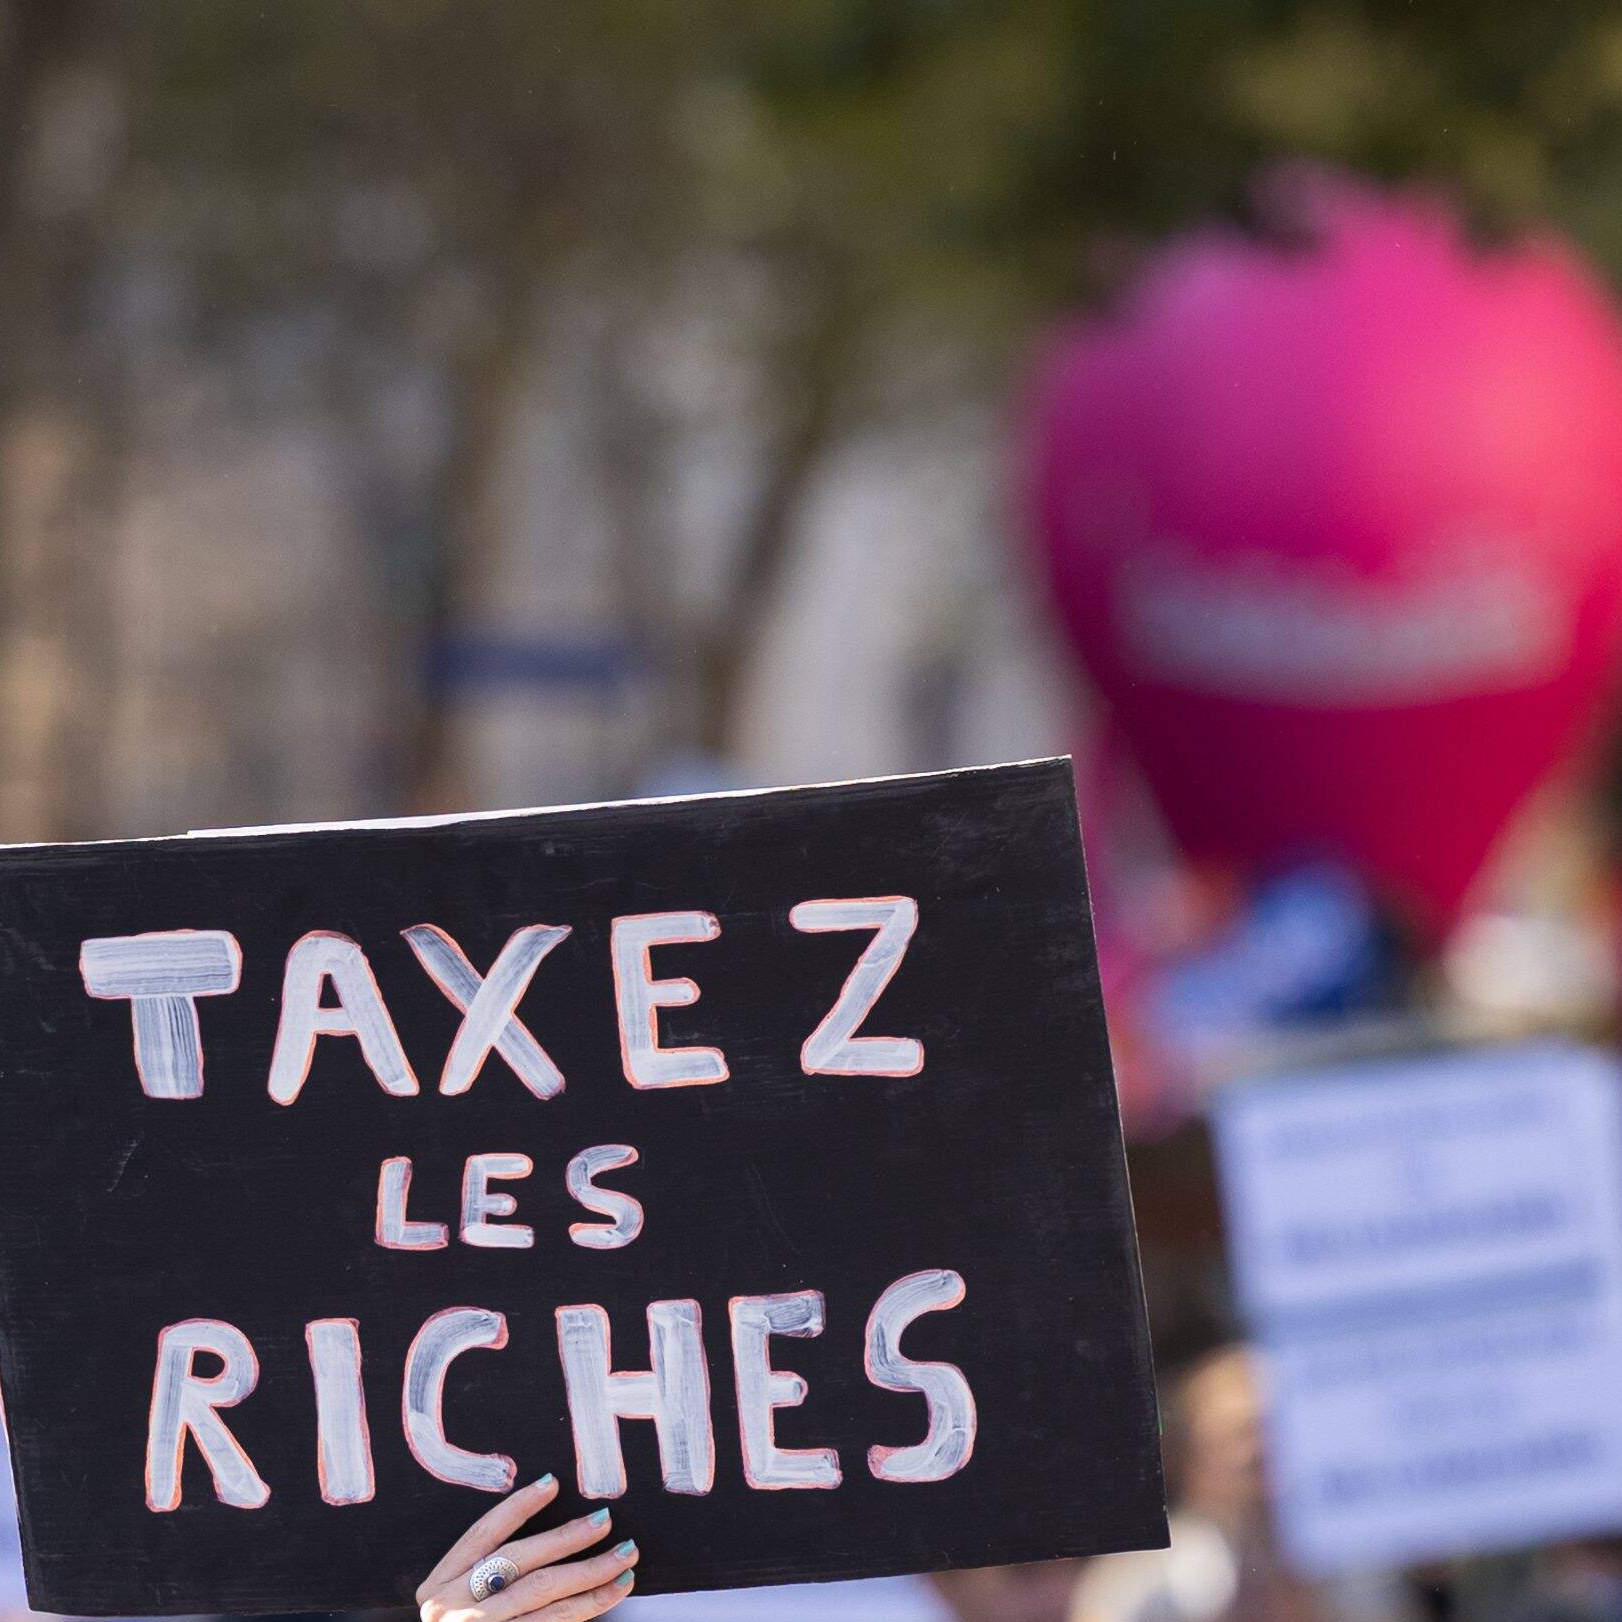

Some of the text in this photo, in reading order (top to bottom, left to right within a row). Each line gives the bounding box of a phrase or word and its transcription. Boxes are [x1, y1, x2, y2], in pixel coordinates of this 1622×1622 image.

[77, 894, 926, 1106] TAXEZ
[374, 1143, 645, 1251] LES
[143, 1267, 979, 1514] RICHES
